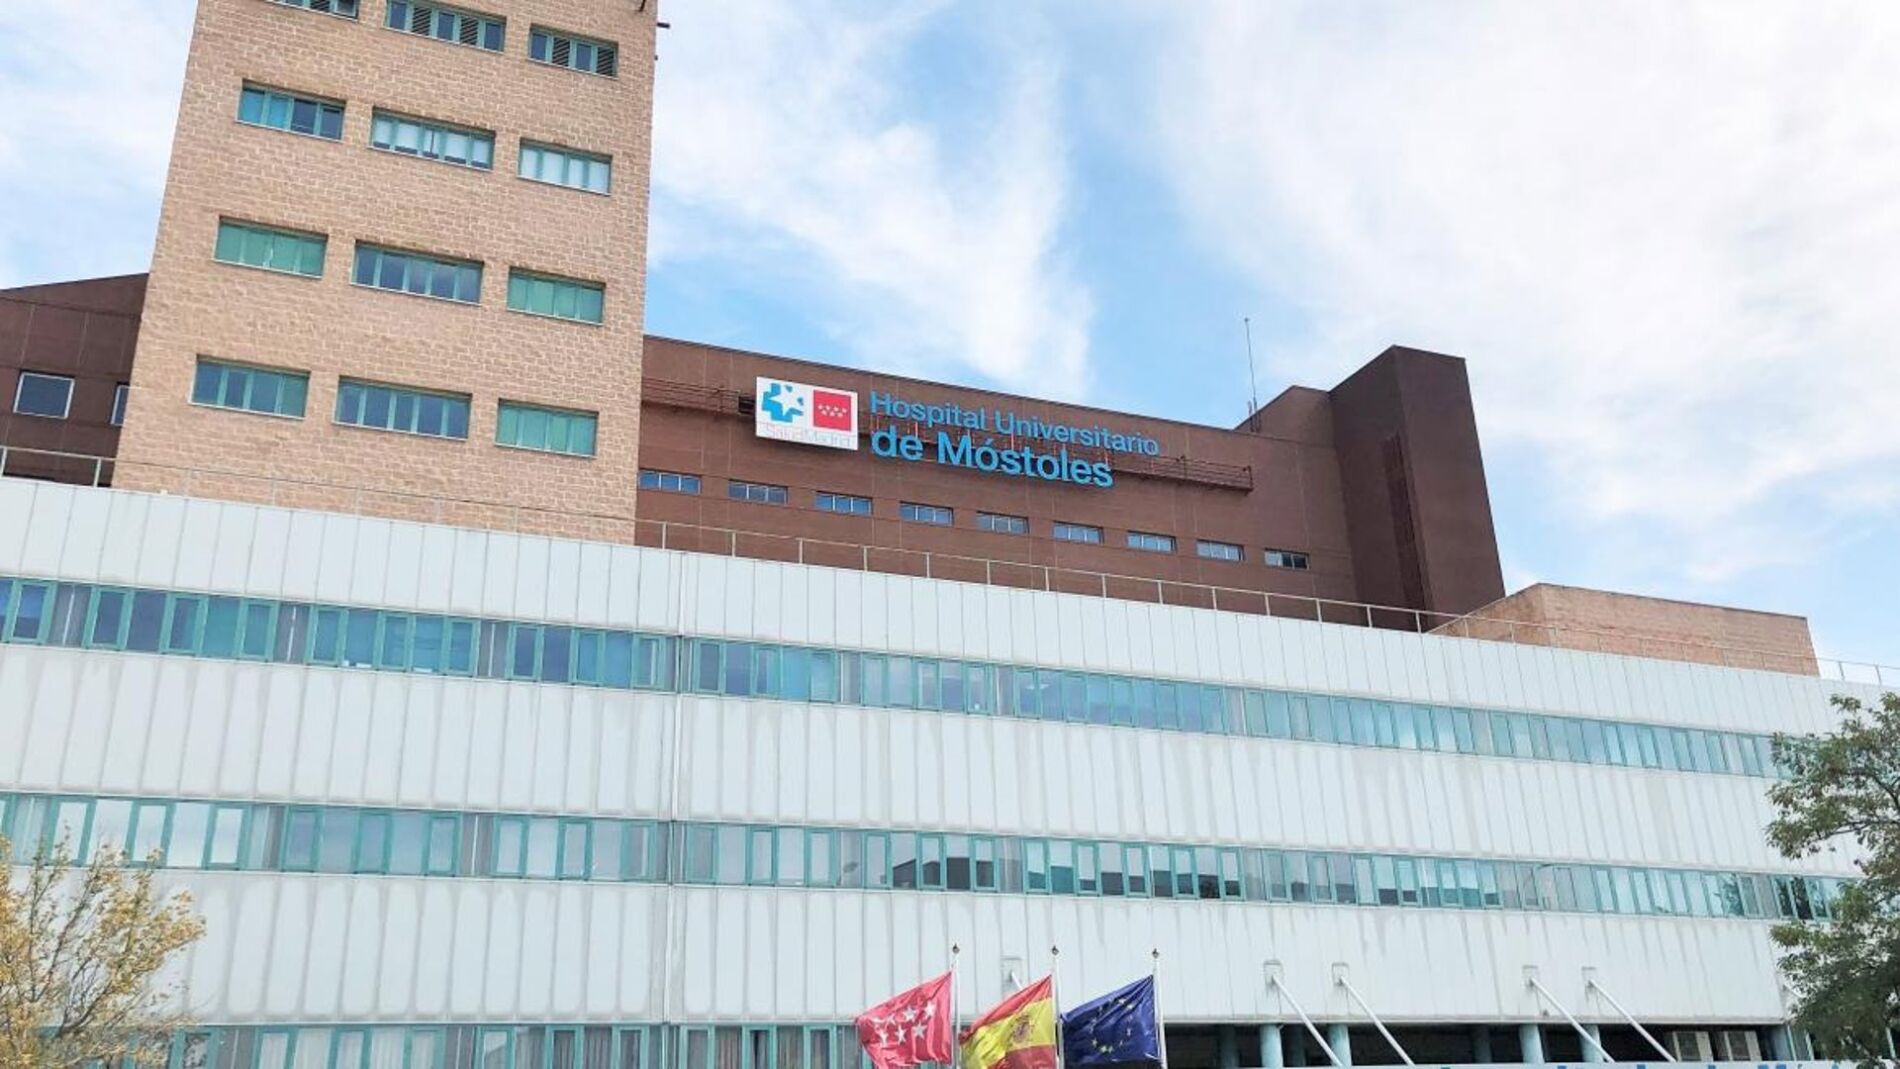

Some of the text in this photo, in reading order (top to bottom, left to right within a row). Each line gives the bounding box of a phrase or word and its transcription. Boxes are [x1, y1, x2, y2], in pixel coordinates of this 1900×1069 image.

[870, 391, 1159, 456] Hospital Universitario
[871, 424, 1113, 487] de Móstoles
